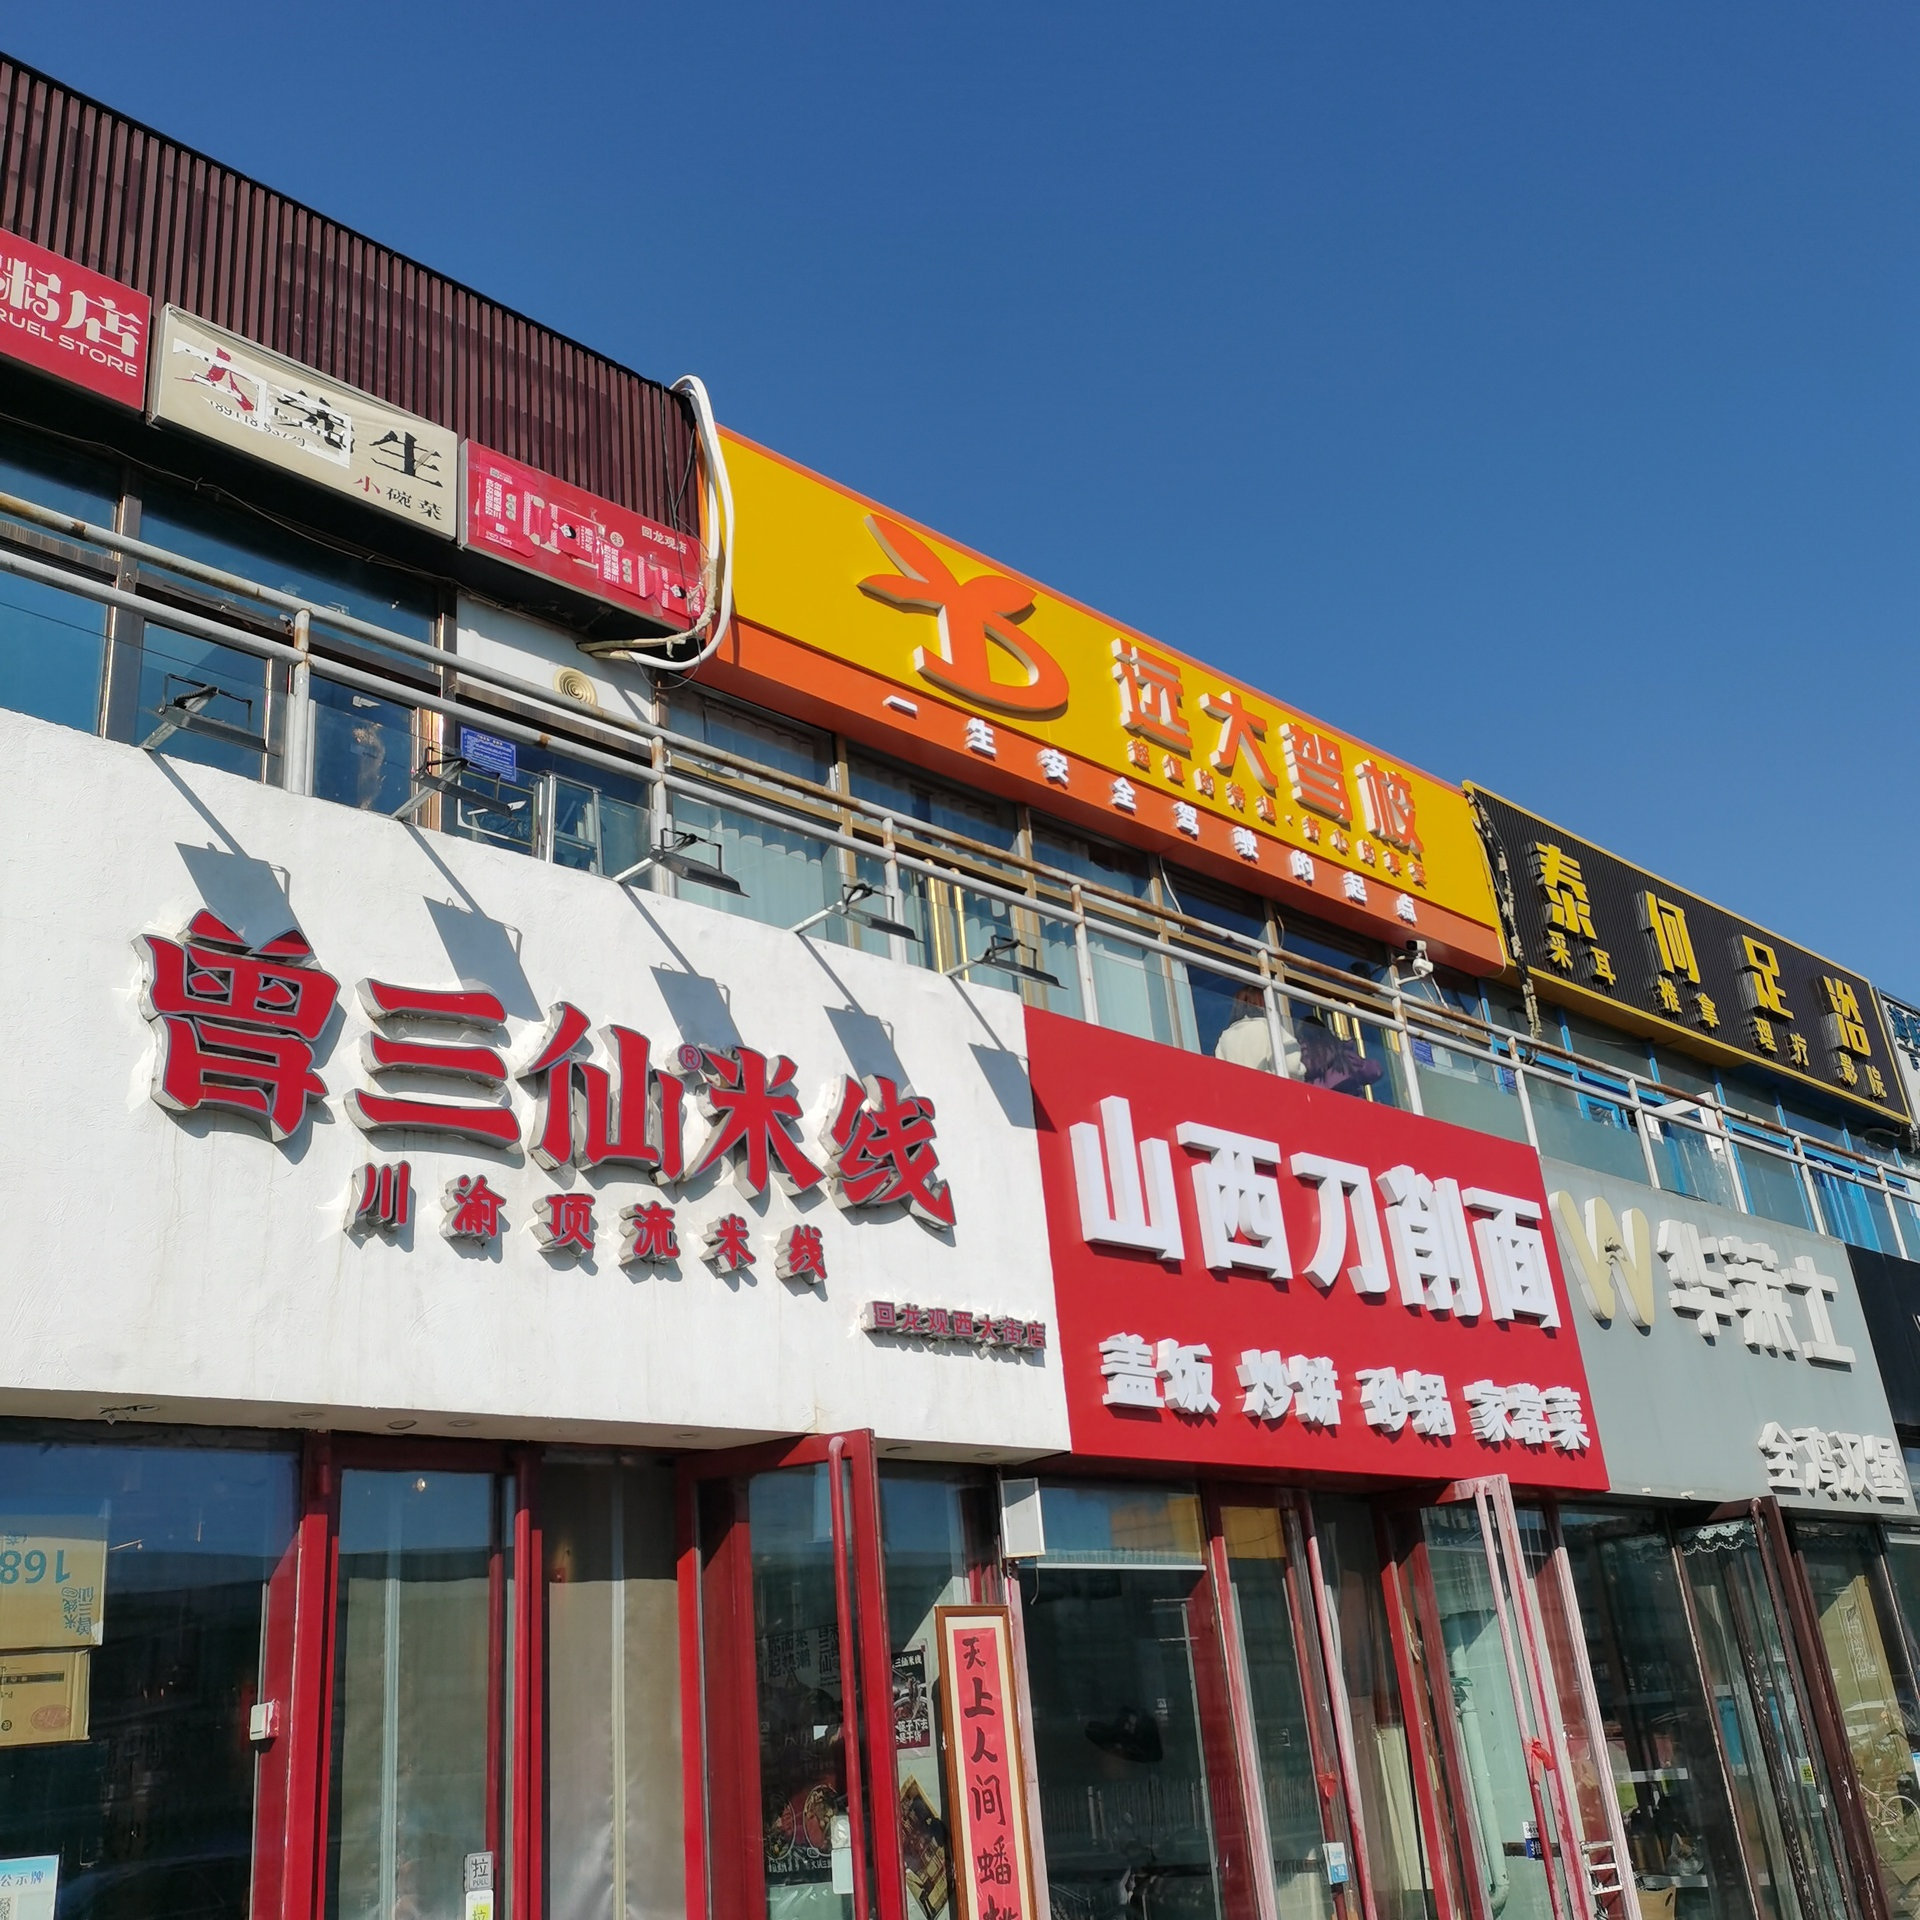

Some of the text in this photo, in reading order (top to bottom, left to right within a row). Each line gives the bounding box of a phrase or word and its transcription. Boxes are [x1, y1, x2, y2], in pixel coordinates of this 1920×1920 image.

[58, 334, 138, 377] STORE
[353, 475, 443, 521] 小碗菜
[641, 525, 687, 555] 回龙观店
[1111, 638, 1424, 853] 远大驾校
[883, 695, 1418, 924] 一生安全驾驶的起点
[1548, 930, 1617, 986] 采耳
[1657, 975, 1720, 1029] 推拿
[1753, 1016, 1810, 1067] 理疗
[136, 909, 956, 1228] 曾三仙米线
[355, 1160, 828, 1282] 川渝顶流米线
[1069, 1095, 1562, 1329] 山西刀削面
[868, 1300, 1047, 1350] 回龙观西大街店
[1656, 1219, 1856, 1364] 华莱士
[1099, 1332, 1591, 1451] 盖饭 炒饼 砂锅 家常菜
[1757, 1421, 1909, 1499] 全鸡汉堡
[0, 1870, 45, 1887] 公示牌
[471, 1858, 489, 1878] 拉
